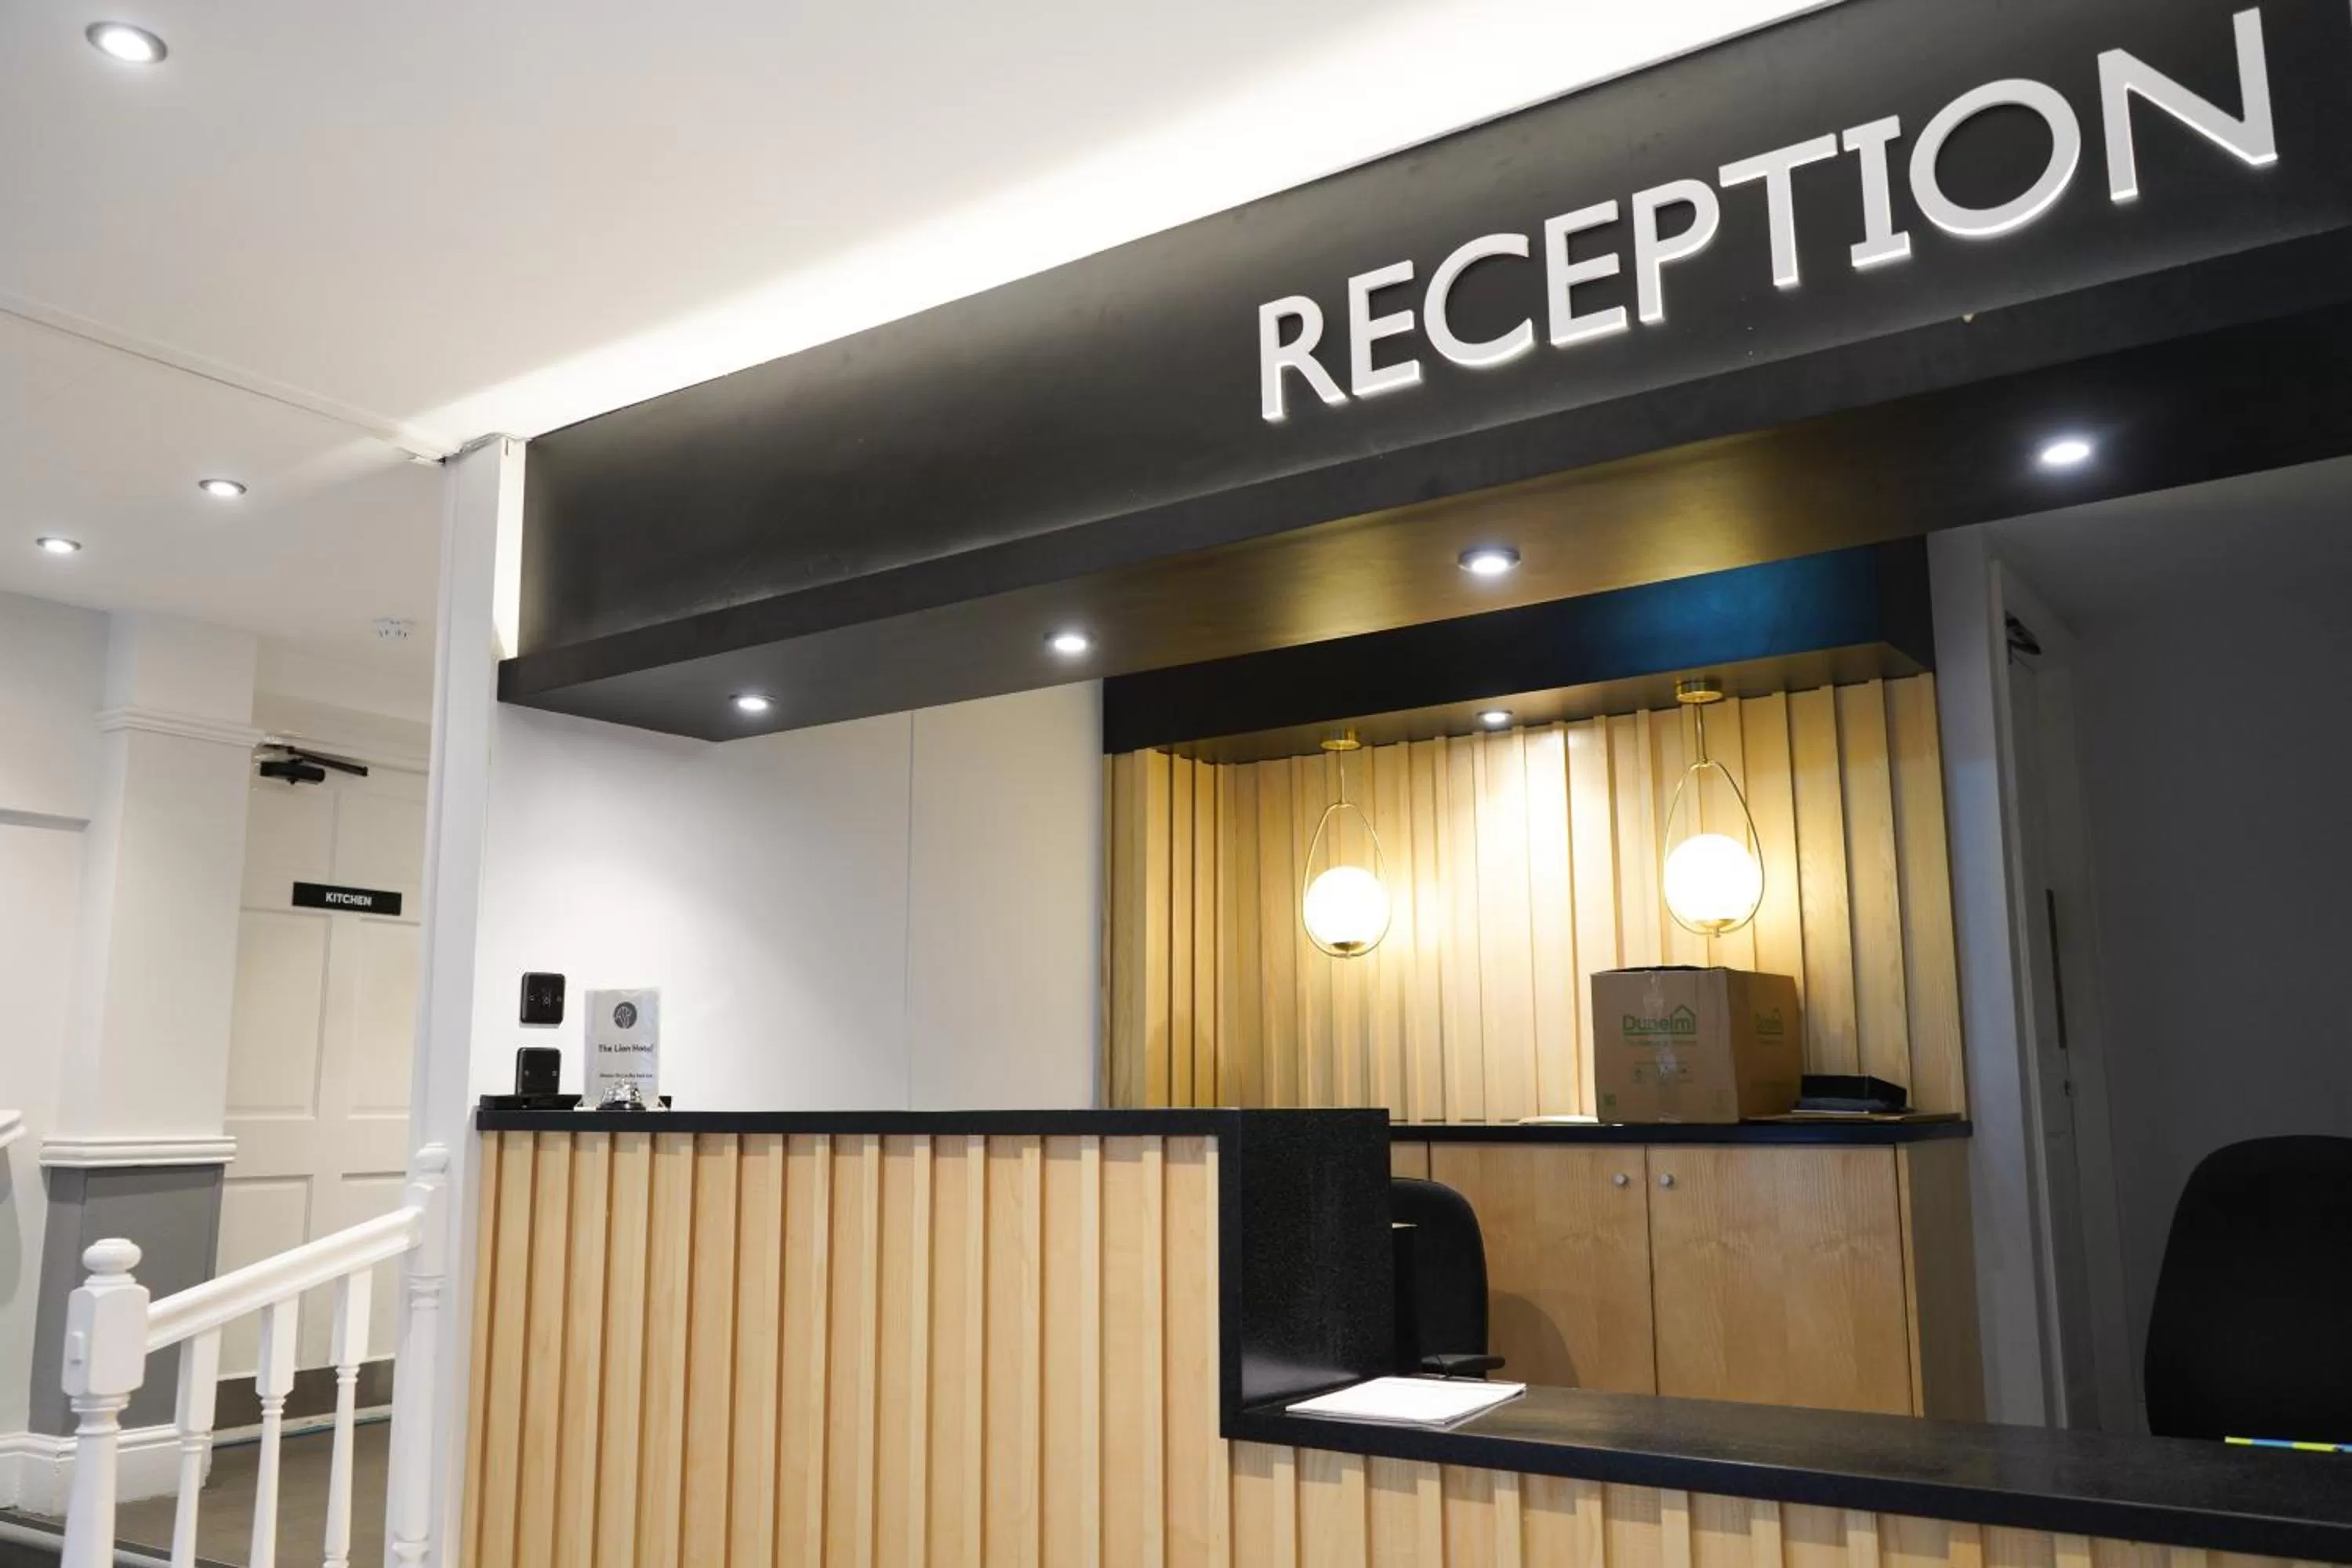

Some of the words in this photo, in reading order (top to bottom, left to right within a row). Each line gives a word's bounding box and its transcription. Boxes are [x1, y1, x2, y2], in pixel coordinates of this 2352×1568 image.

[1259, 8, 2278, 421] RECEPTION
[325, 891, 372, 906] KITCHEN
[598, 1044, 612, 1053] The
[614, 1044, 631, 1053] Lion
[632, 1044, 653, 1053] Hotel
